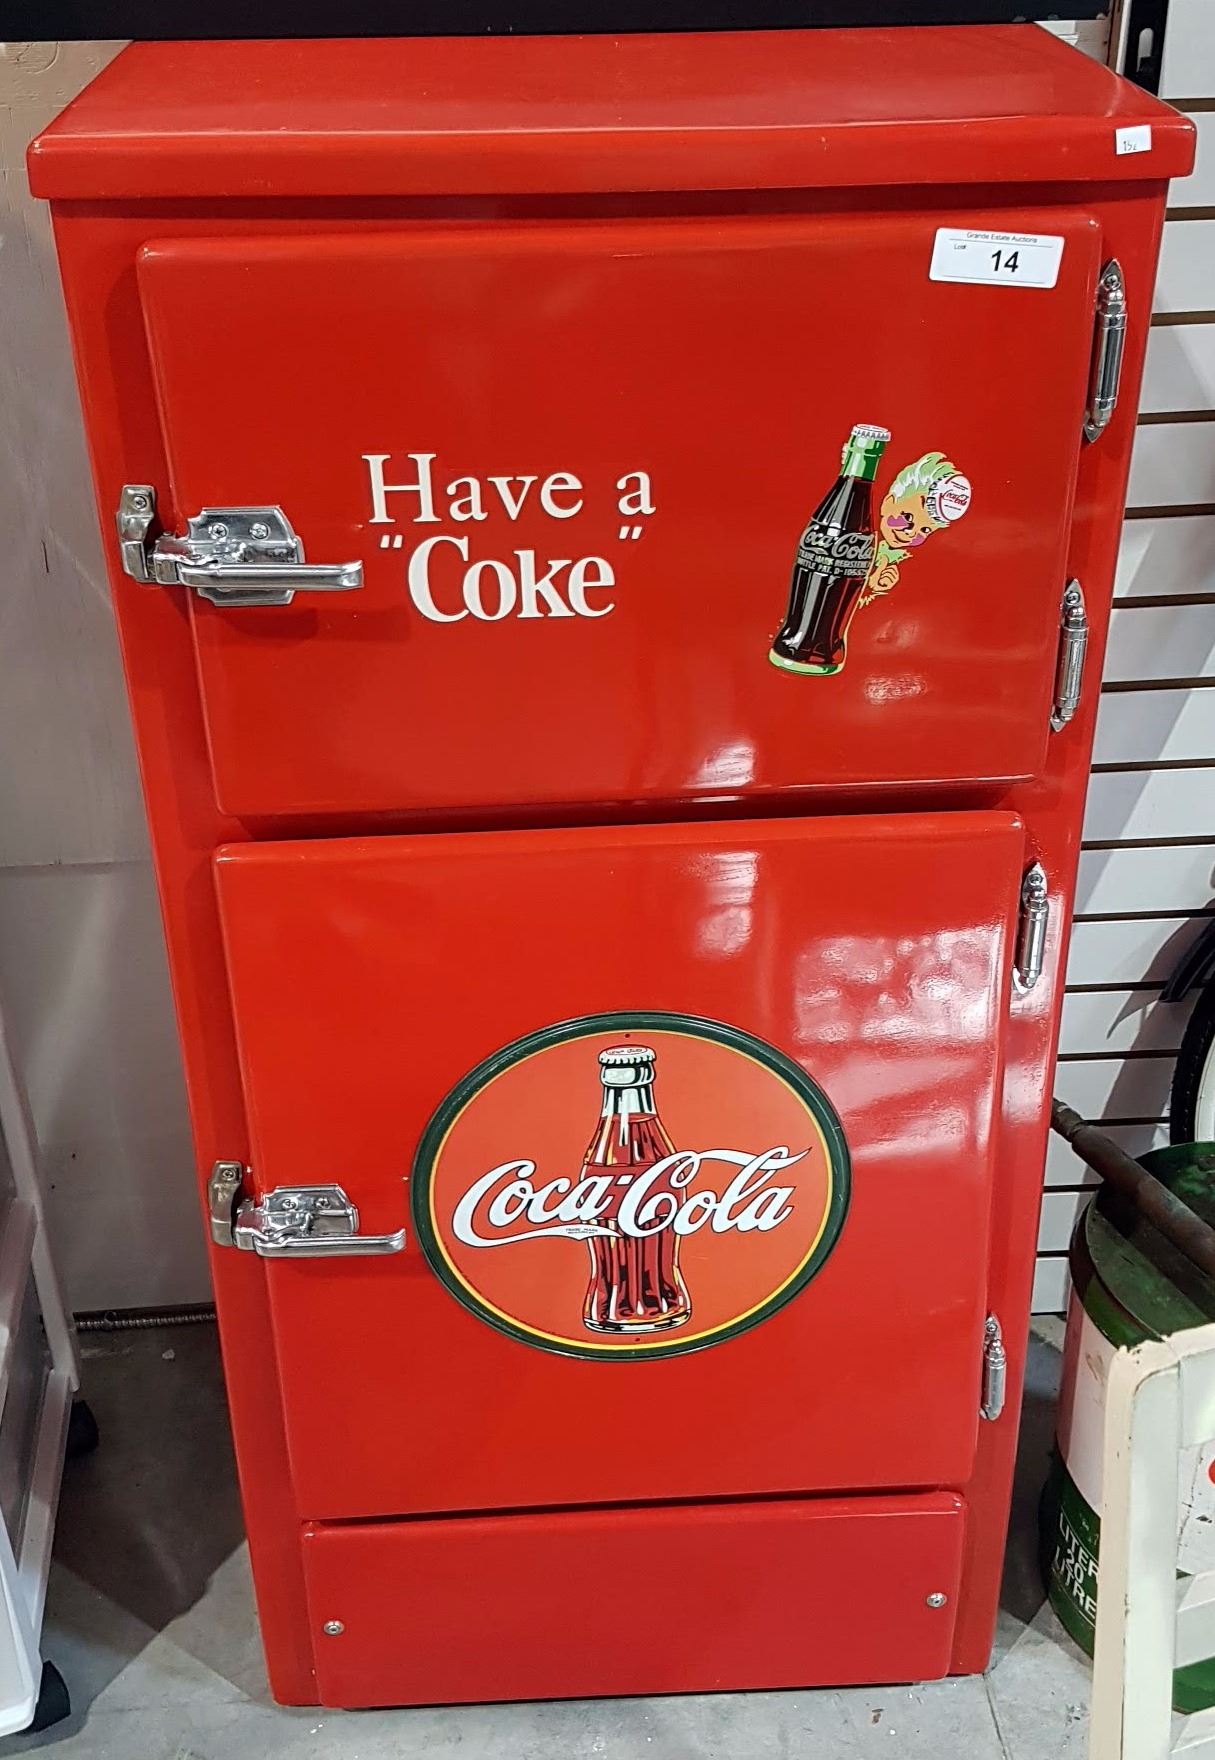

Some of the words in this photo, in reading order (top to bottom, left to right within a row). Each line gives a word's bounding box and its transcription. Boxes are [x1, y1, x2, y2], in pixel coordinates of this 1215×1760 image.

[966, 232, 989, 240] Grande
[991, 233, 1010, 241] Estate
[1011, 235, 1038, 243] Auctions
[991, 249, 1019, 273] 14
[361, 453, 583, 523] Have
[616, 471, 656, 516] a
[452, 1146, 812, 1248] Coca-Cola
[1066, 1548, 1084, 1584] 20
